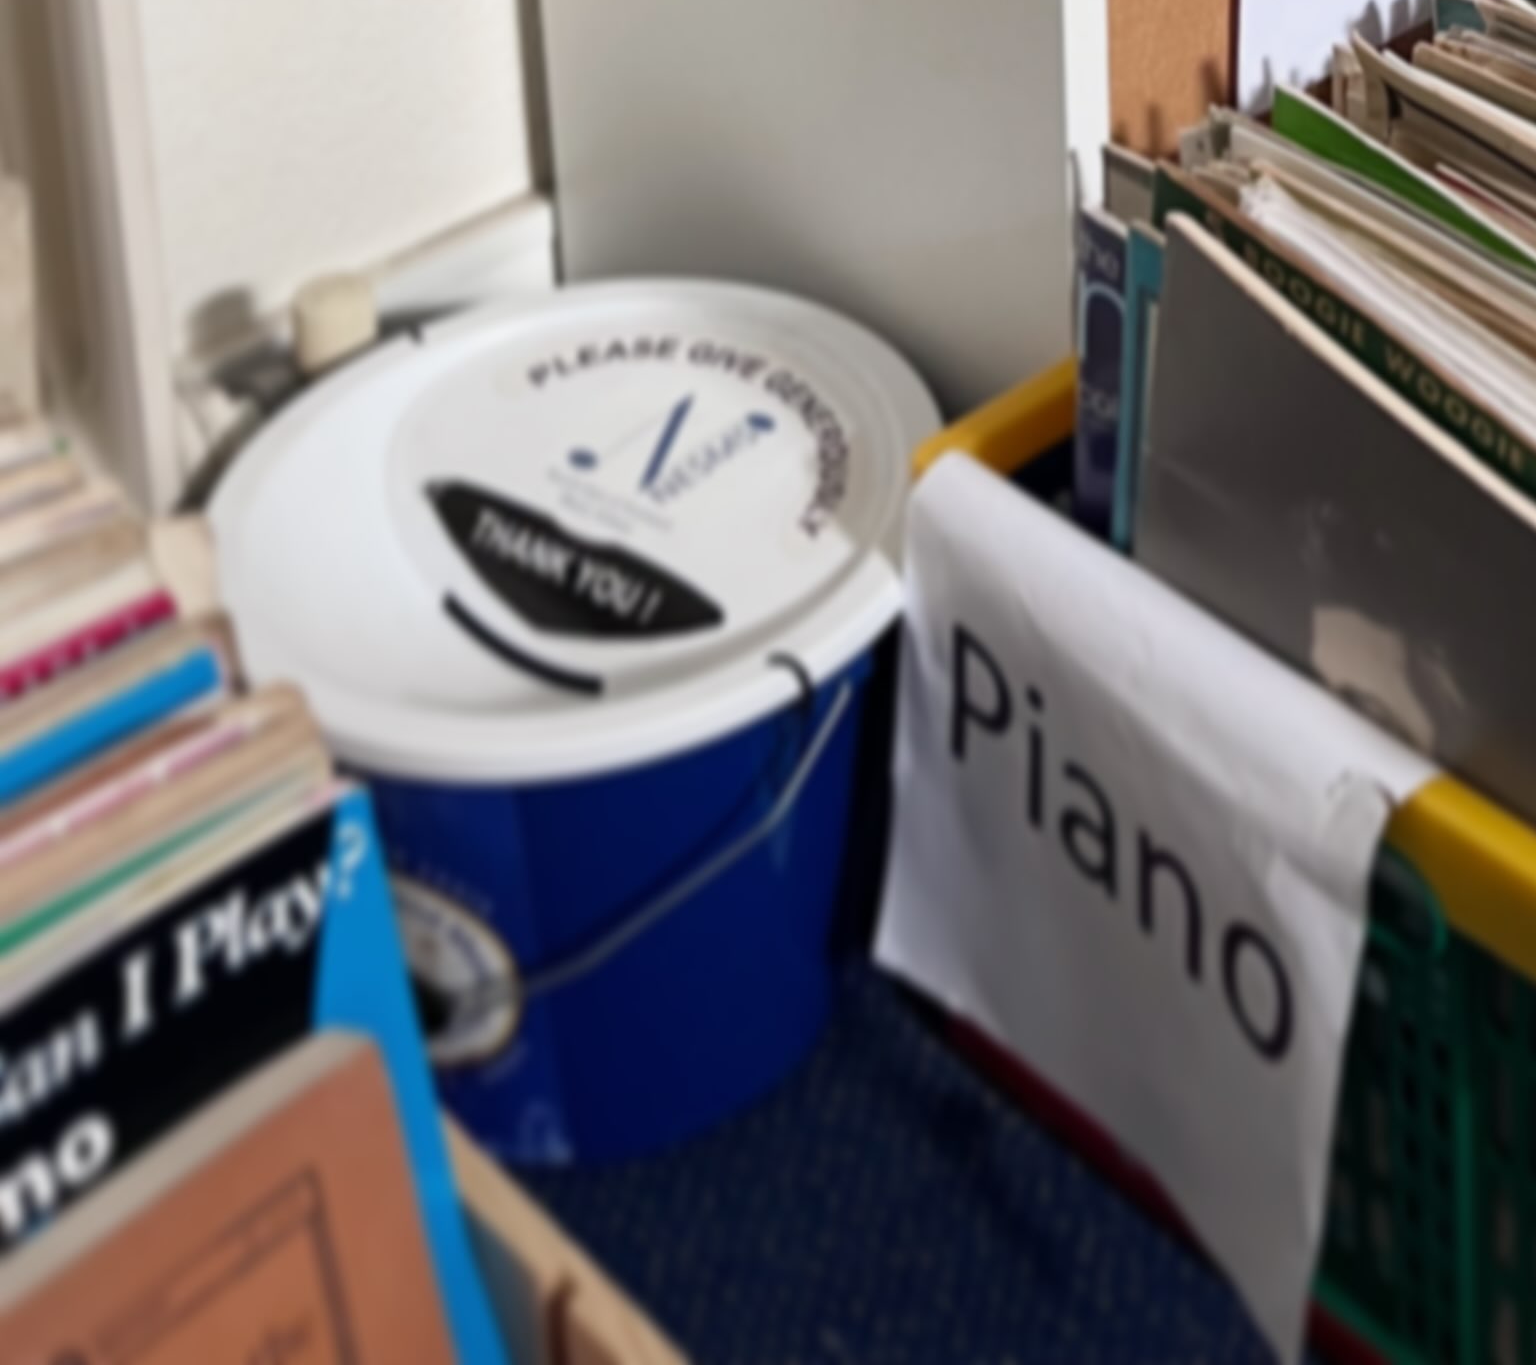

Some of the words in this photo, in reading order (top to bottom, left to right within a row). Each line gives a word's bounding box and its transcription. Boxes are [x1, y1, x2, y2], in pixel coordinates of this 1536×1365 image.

[527, 336, 679, 388] PLEASE
[685, 338, 766, 382] GIVE
[1384, 342, 1528, 473] WOOGIE
[472, 505, 578, 587] THANK
[948, 622, 1296, 1067] Piano
[119, 948, 153, 1041] I
[174, 819, 368, 1009] Play?
